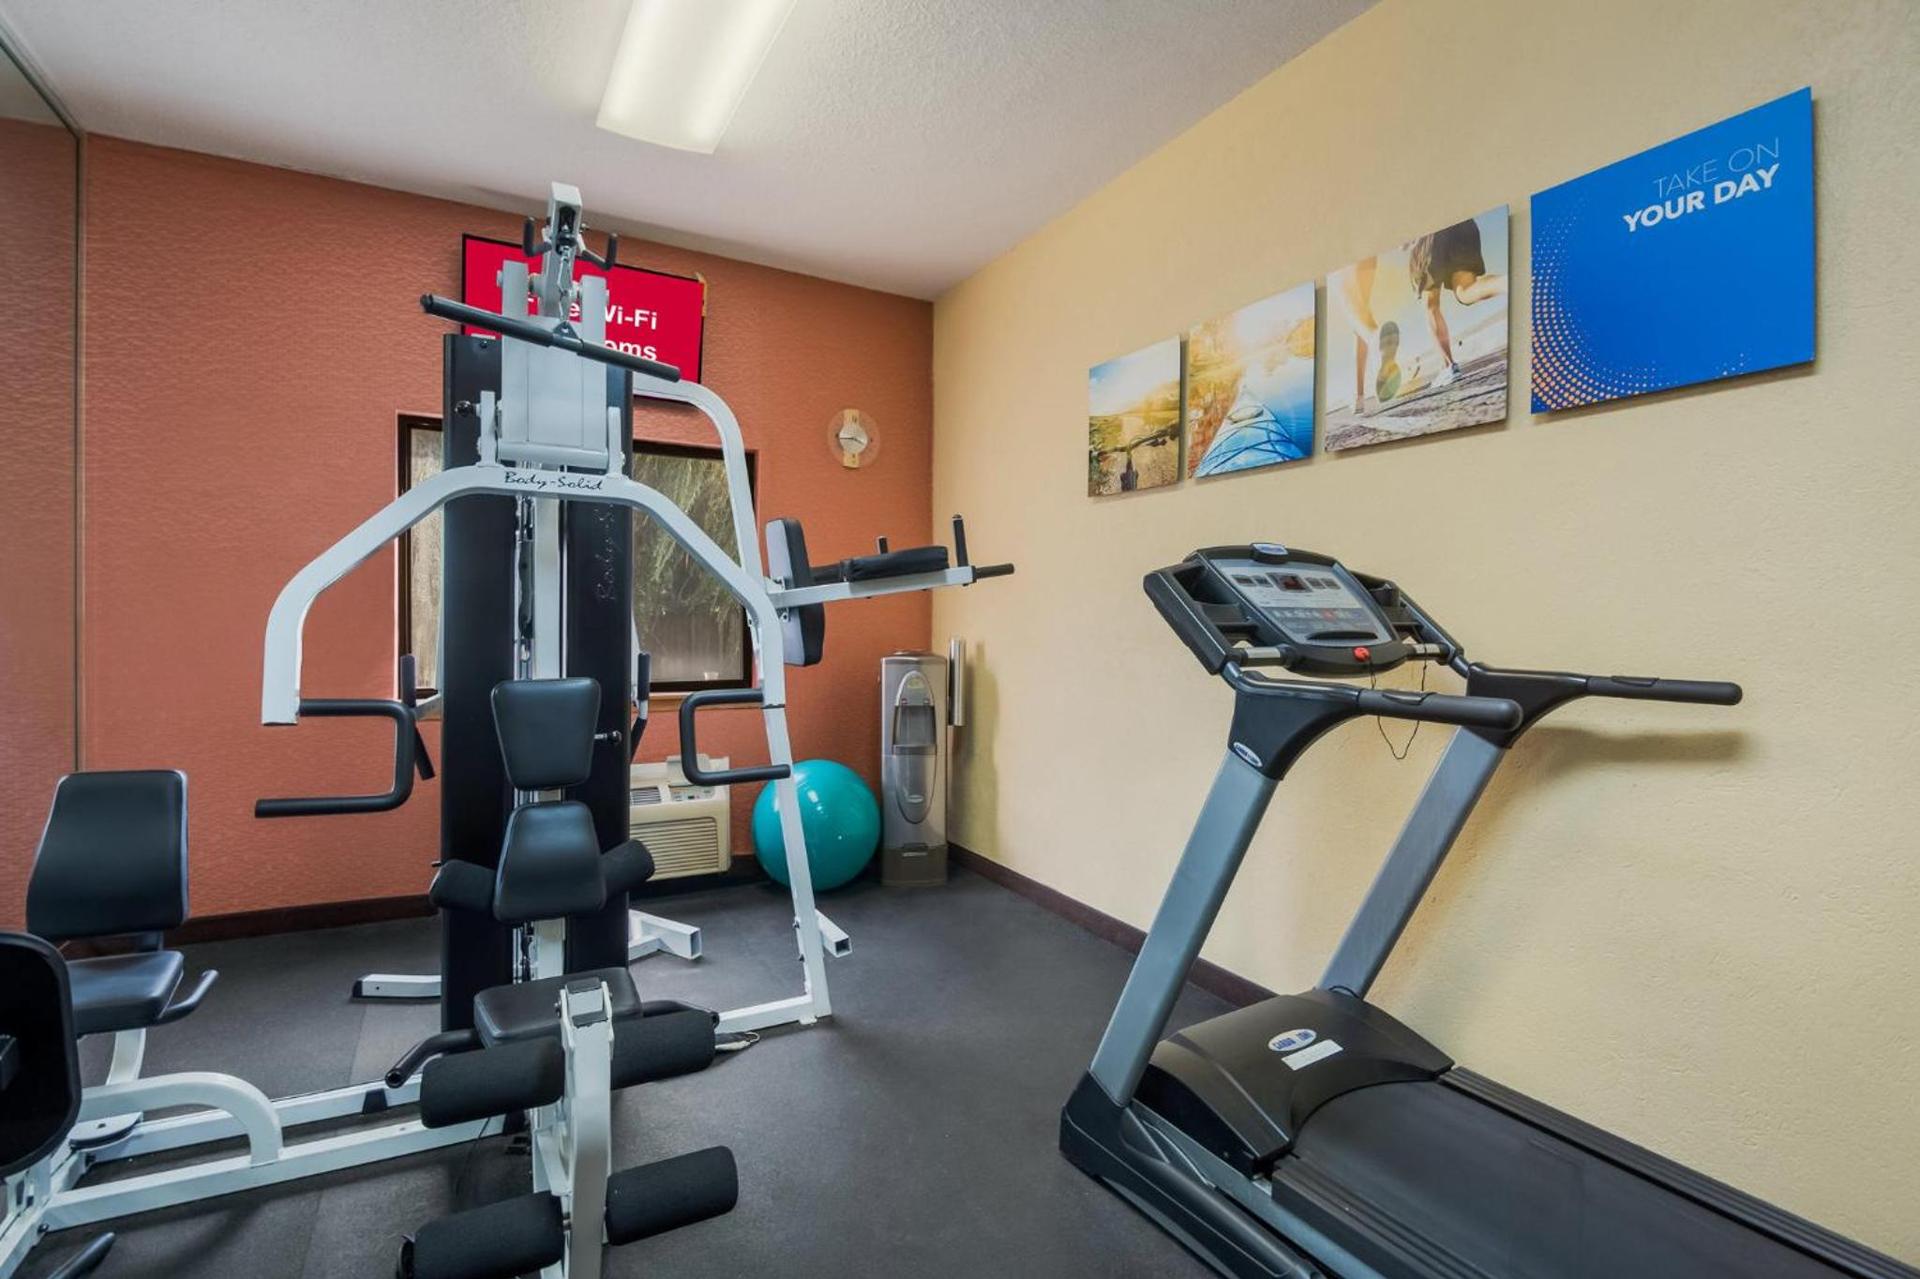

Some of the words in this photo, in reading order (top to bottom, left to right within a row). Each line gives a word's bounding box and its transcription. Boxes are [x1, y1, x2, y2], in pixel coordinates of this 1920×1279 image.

[1623, 190, 1706, 233] YOUR
[1714, 162, 1780, 205] DAY
[1653, 159, 1719, 199] TAKE
[1728, 137, 1780, 173] ON
[504, 471, 603, 490] Body-Solid
